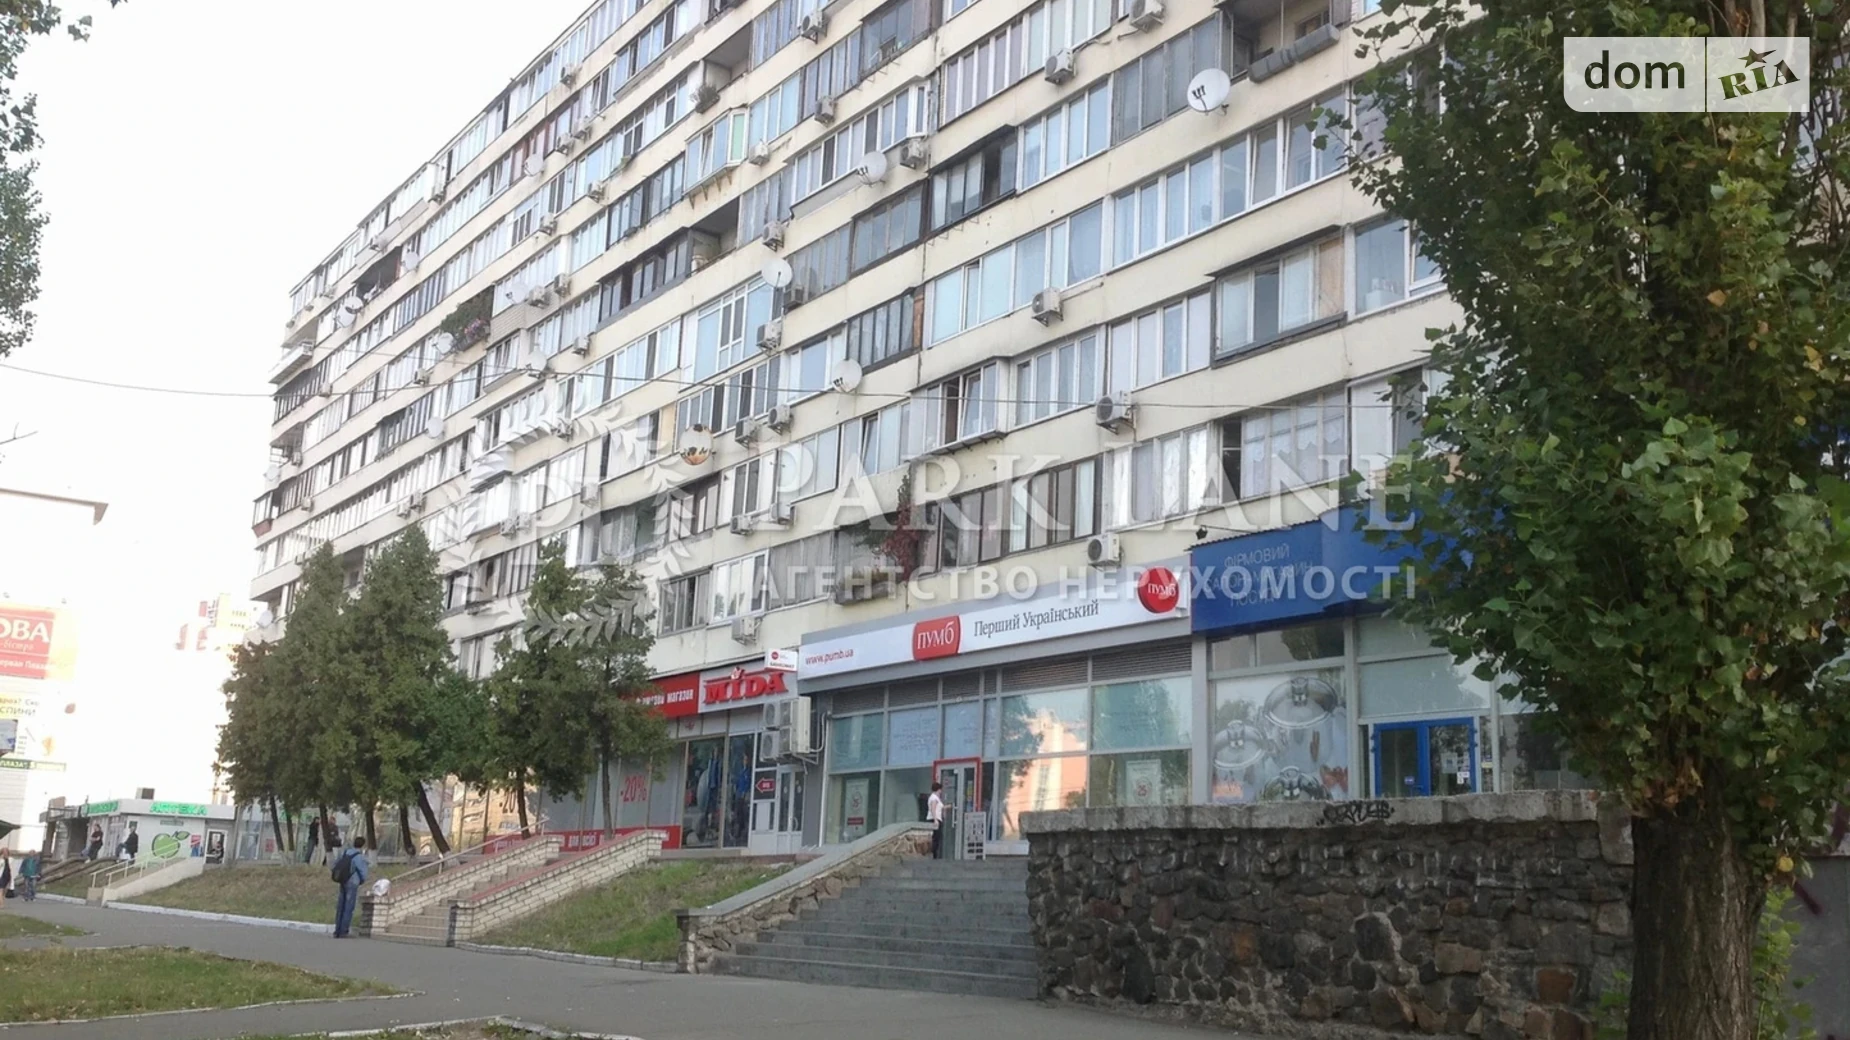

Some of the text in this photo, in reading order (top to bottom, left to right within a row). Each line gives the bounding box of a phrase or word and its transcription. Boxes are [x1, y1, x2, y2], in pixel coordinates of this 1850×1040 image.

[1223, 541, 1290, 568] ФІРМОВИЙ
[973, 600, 1100, 639] Перший Український
[805, 647, 855, 666] www.pumb.ua
[703, 671, 789, 706] MIDA
[620, 776, 647, 802] -20%
